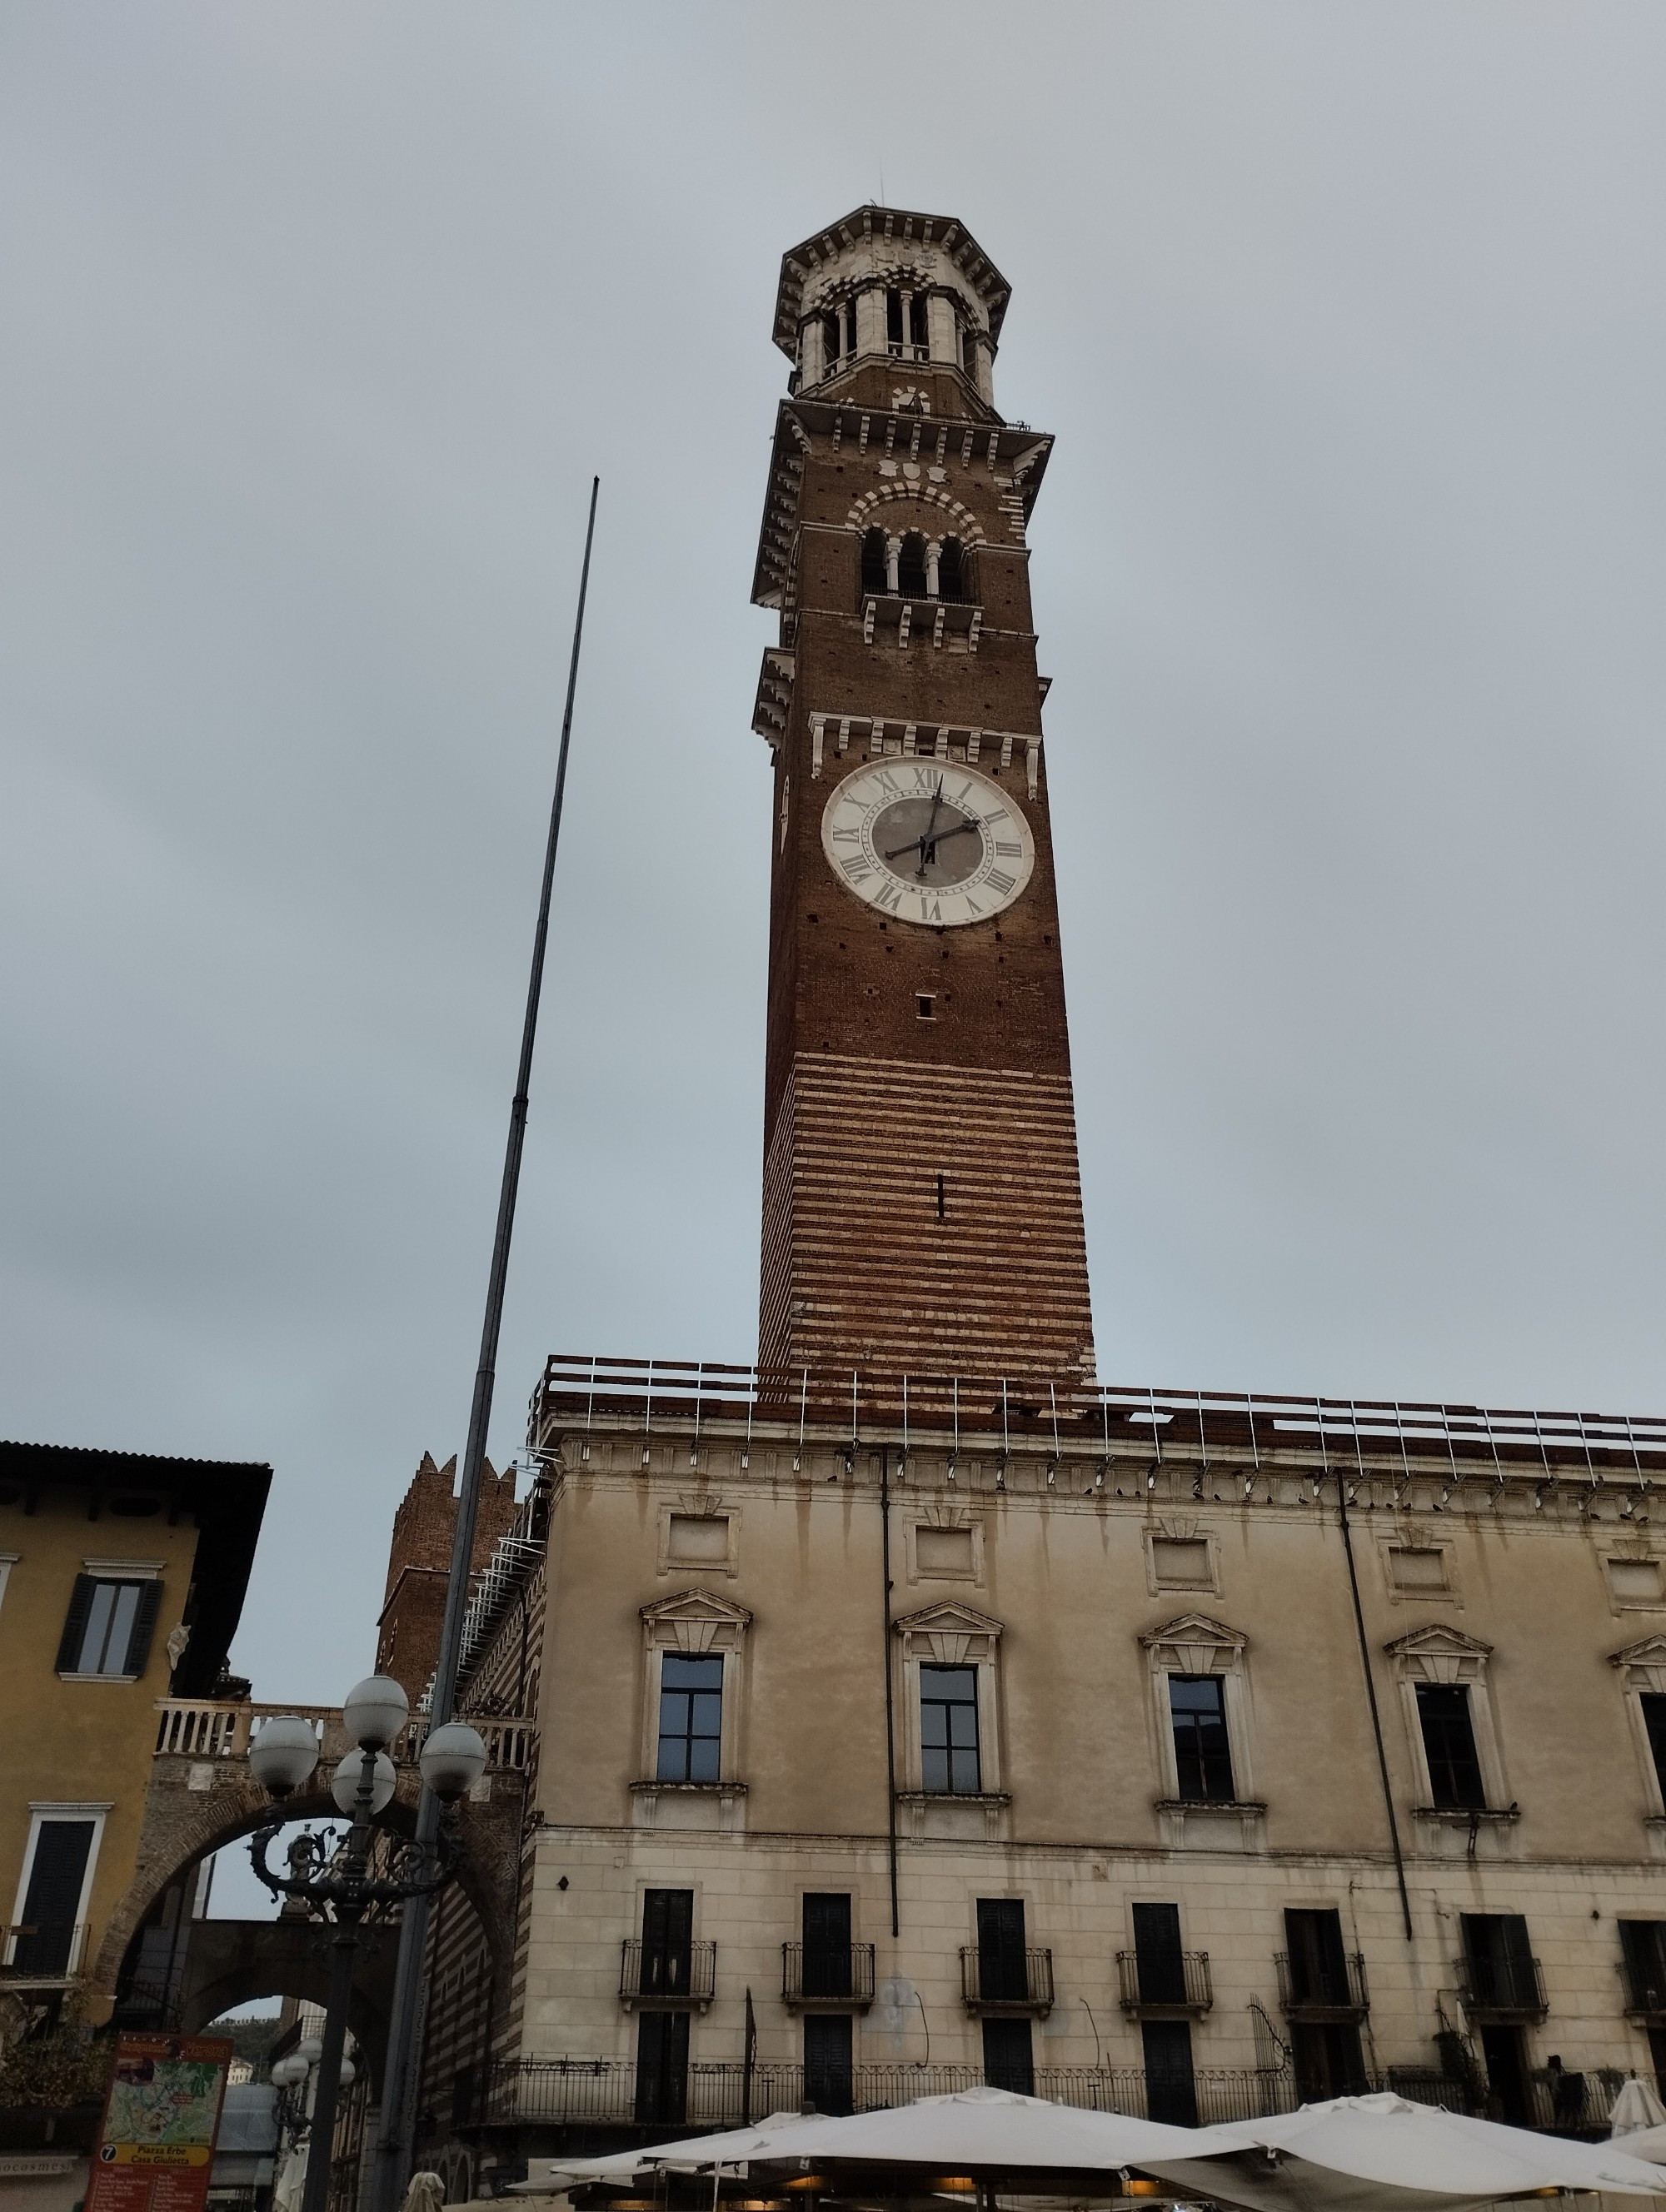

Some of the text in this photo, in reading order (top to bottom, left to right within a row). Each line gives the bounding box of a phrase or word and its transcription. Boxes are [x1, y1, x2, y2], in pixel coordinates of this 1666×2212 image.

[871, 770, 900, 795] XI
[912, 767, 938, 789] XII
[842, 792, 870, 813] X
[983, 809, 1010, 825] II
[833, 825, 859, 843] IX
[996, 842, 1021, 858] III
[874, 883, 903, 911] VII
[965, 895, 983, 914] V
[920, 897, 941, 920] VI
[104, 2146, 114, 2160] 7
[137, 2146, 187, 2155] Piazza Erbe
[0, 2162, 73, 2172] ocosmesi
[131, 2155, 190, 2165] Casa Giulietta
